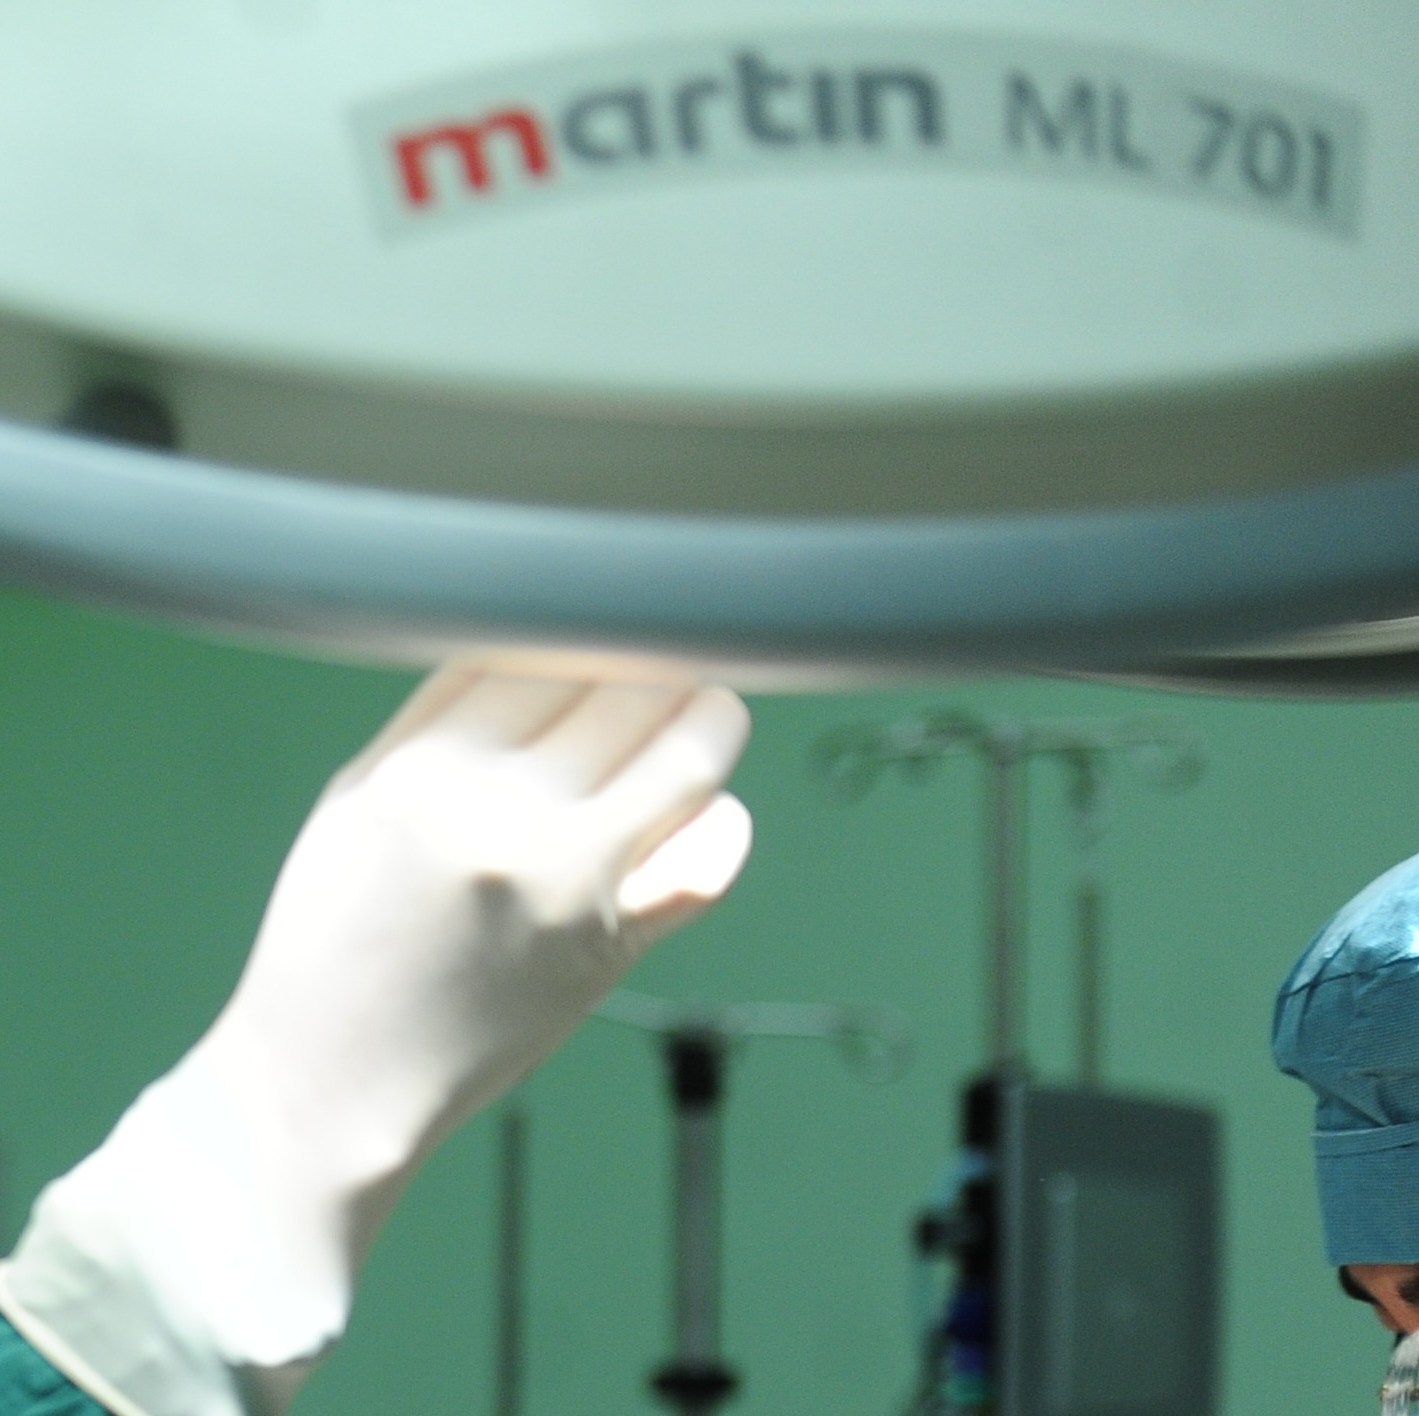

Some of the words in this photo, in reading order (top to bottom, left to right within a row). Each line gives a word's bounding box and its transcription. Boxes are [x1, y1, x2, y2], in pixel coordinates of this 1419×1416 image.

[389, 50, 945, 211] martin
[1004, 70, 1154, 174] ML
[1183, 92, 1336, 209] 701
